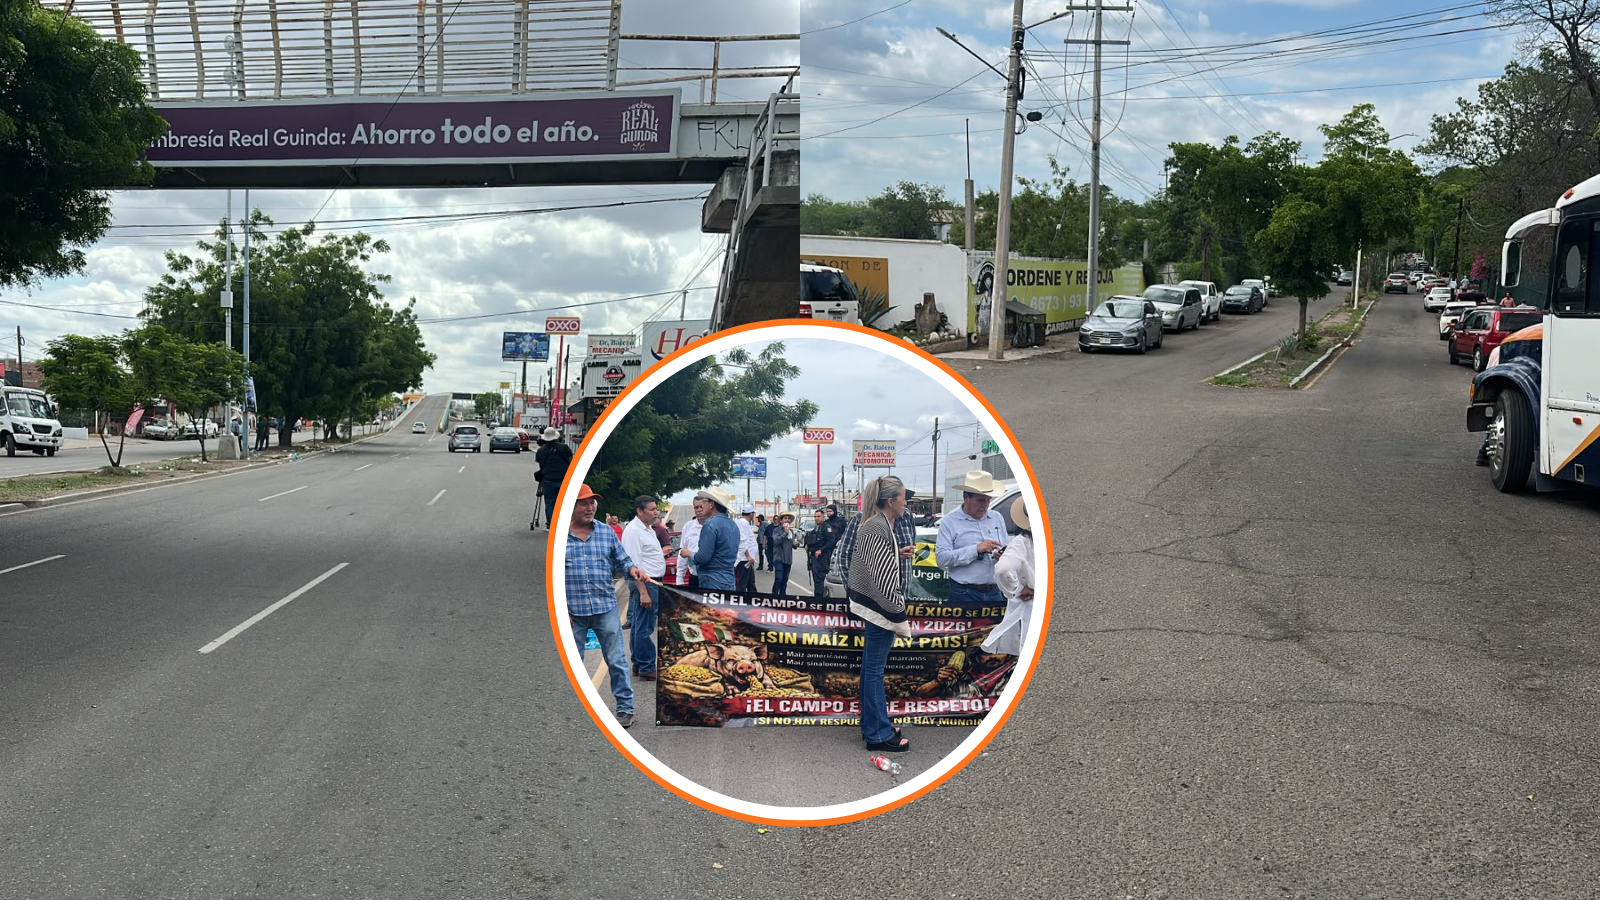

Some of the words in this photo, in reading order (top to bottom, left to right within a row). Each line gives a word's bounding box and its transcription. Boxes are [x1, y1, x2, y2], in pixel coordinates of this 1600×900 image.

[621, 108, 659, 133] REAL
[229, 128, 269, 147] Real
[273, 128, 346, 147] Guinda:
[350, 122, 436, 145] Ahorro
[441, 116, 511, 144] todo
[516, 120, 539, 143] el
[543, 120, 600, 142] año.
[862, 260, 881, 271] DE
[1007, 268, 1062, 286] ORDENE
[1065, 270, 1074, 286] Y
[1076, 268, 1114, 285] REOJA
[546, 319, 579, 331] OXXO
[804, 431, 834, 440] OXXO
[912, 569, 941, 581] Urge
[729, 594, 748, 607] EL
[751, 597, 807, 610] CAMPO
[809, 603, 823, 611] SE
[826, 602, 848, 613] DET
[905, 603, 963, 618] MÉXICO
[965, 609, 979, 617] SE
[791, 613, 822, 626] HAY
[824, 615, 866, 629] MUN
[923, 620, 973, 632] 2026!
[760, 631, 797, 645] ¡SIN
[801, 630, 849, 647] MAÍZ
[893, 637, 915, 649] AY
[919, 634, 969, 649] PAÍS!
[806, 660, 848, 668] sinaloense
[779, 700, 844, 713] CAMPO
[904, 698, 991, 713] RESPETO!
[773, 717, 791, 725] NO
[795, 717, 817, 725] HAY
[820, 718, 860, 726] RESPUE
[913, 717, 936, 725] HAY
